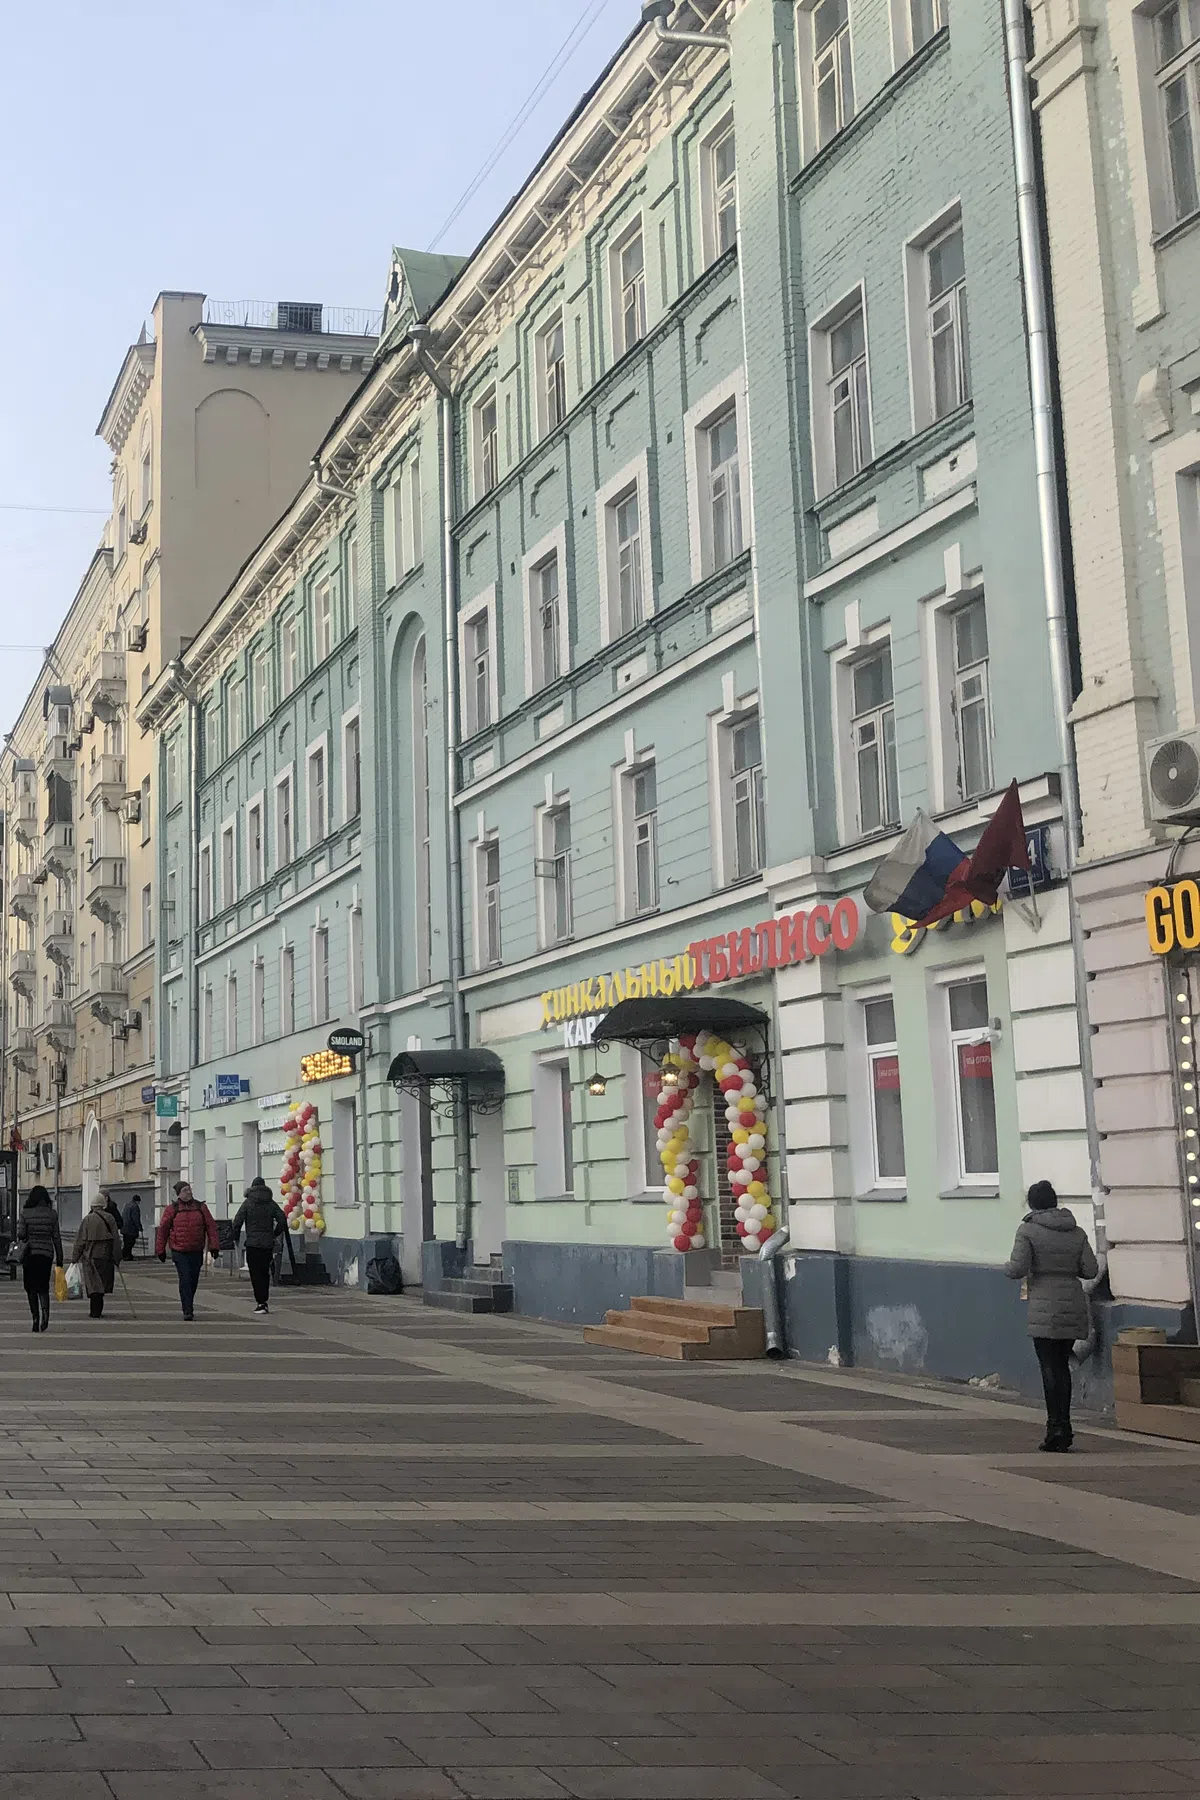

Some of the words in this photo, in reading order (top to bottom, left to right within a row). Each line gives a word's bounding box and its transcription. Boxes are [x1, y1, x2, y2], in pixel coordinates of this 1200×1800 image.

[689, 896, 859, 987] ТБИЛИСО
[330, 1036, 363, 1047] SMOLAND
[564, 1013, 607, 1048] КАР
